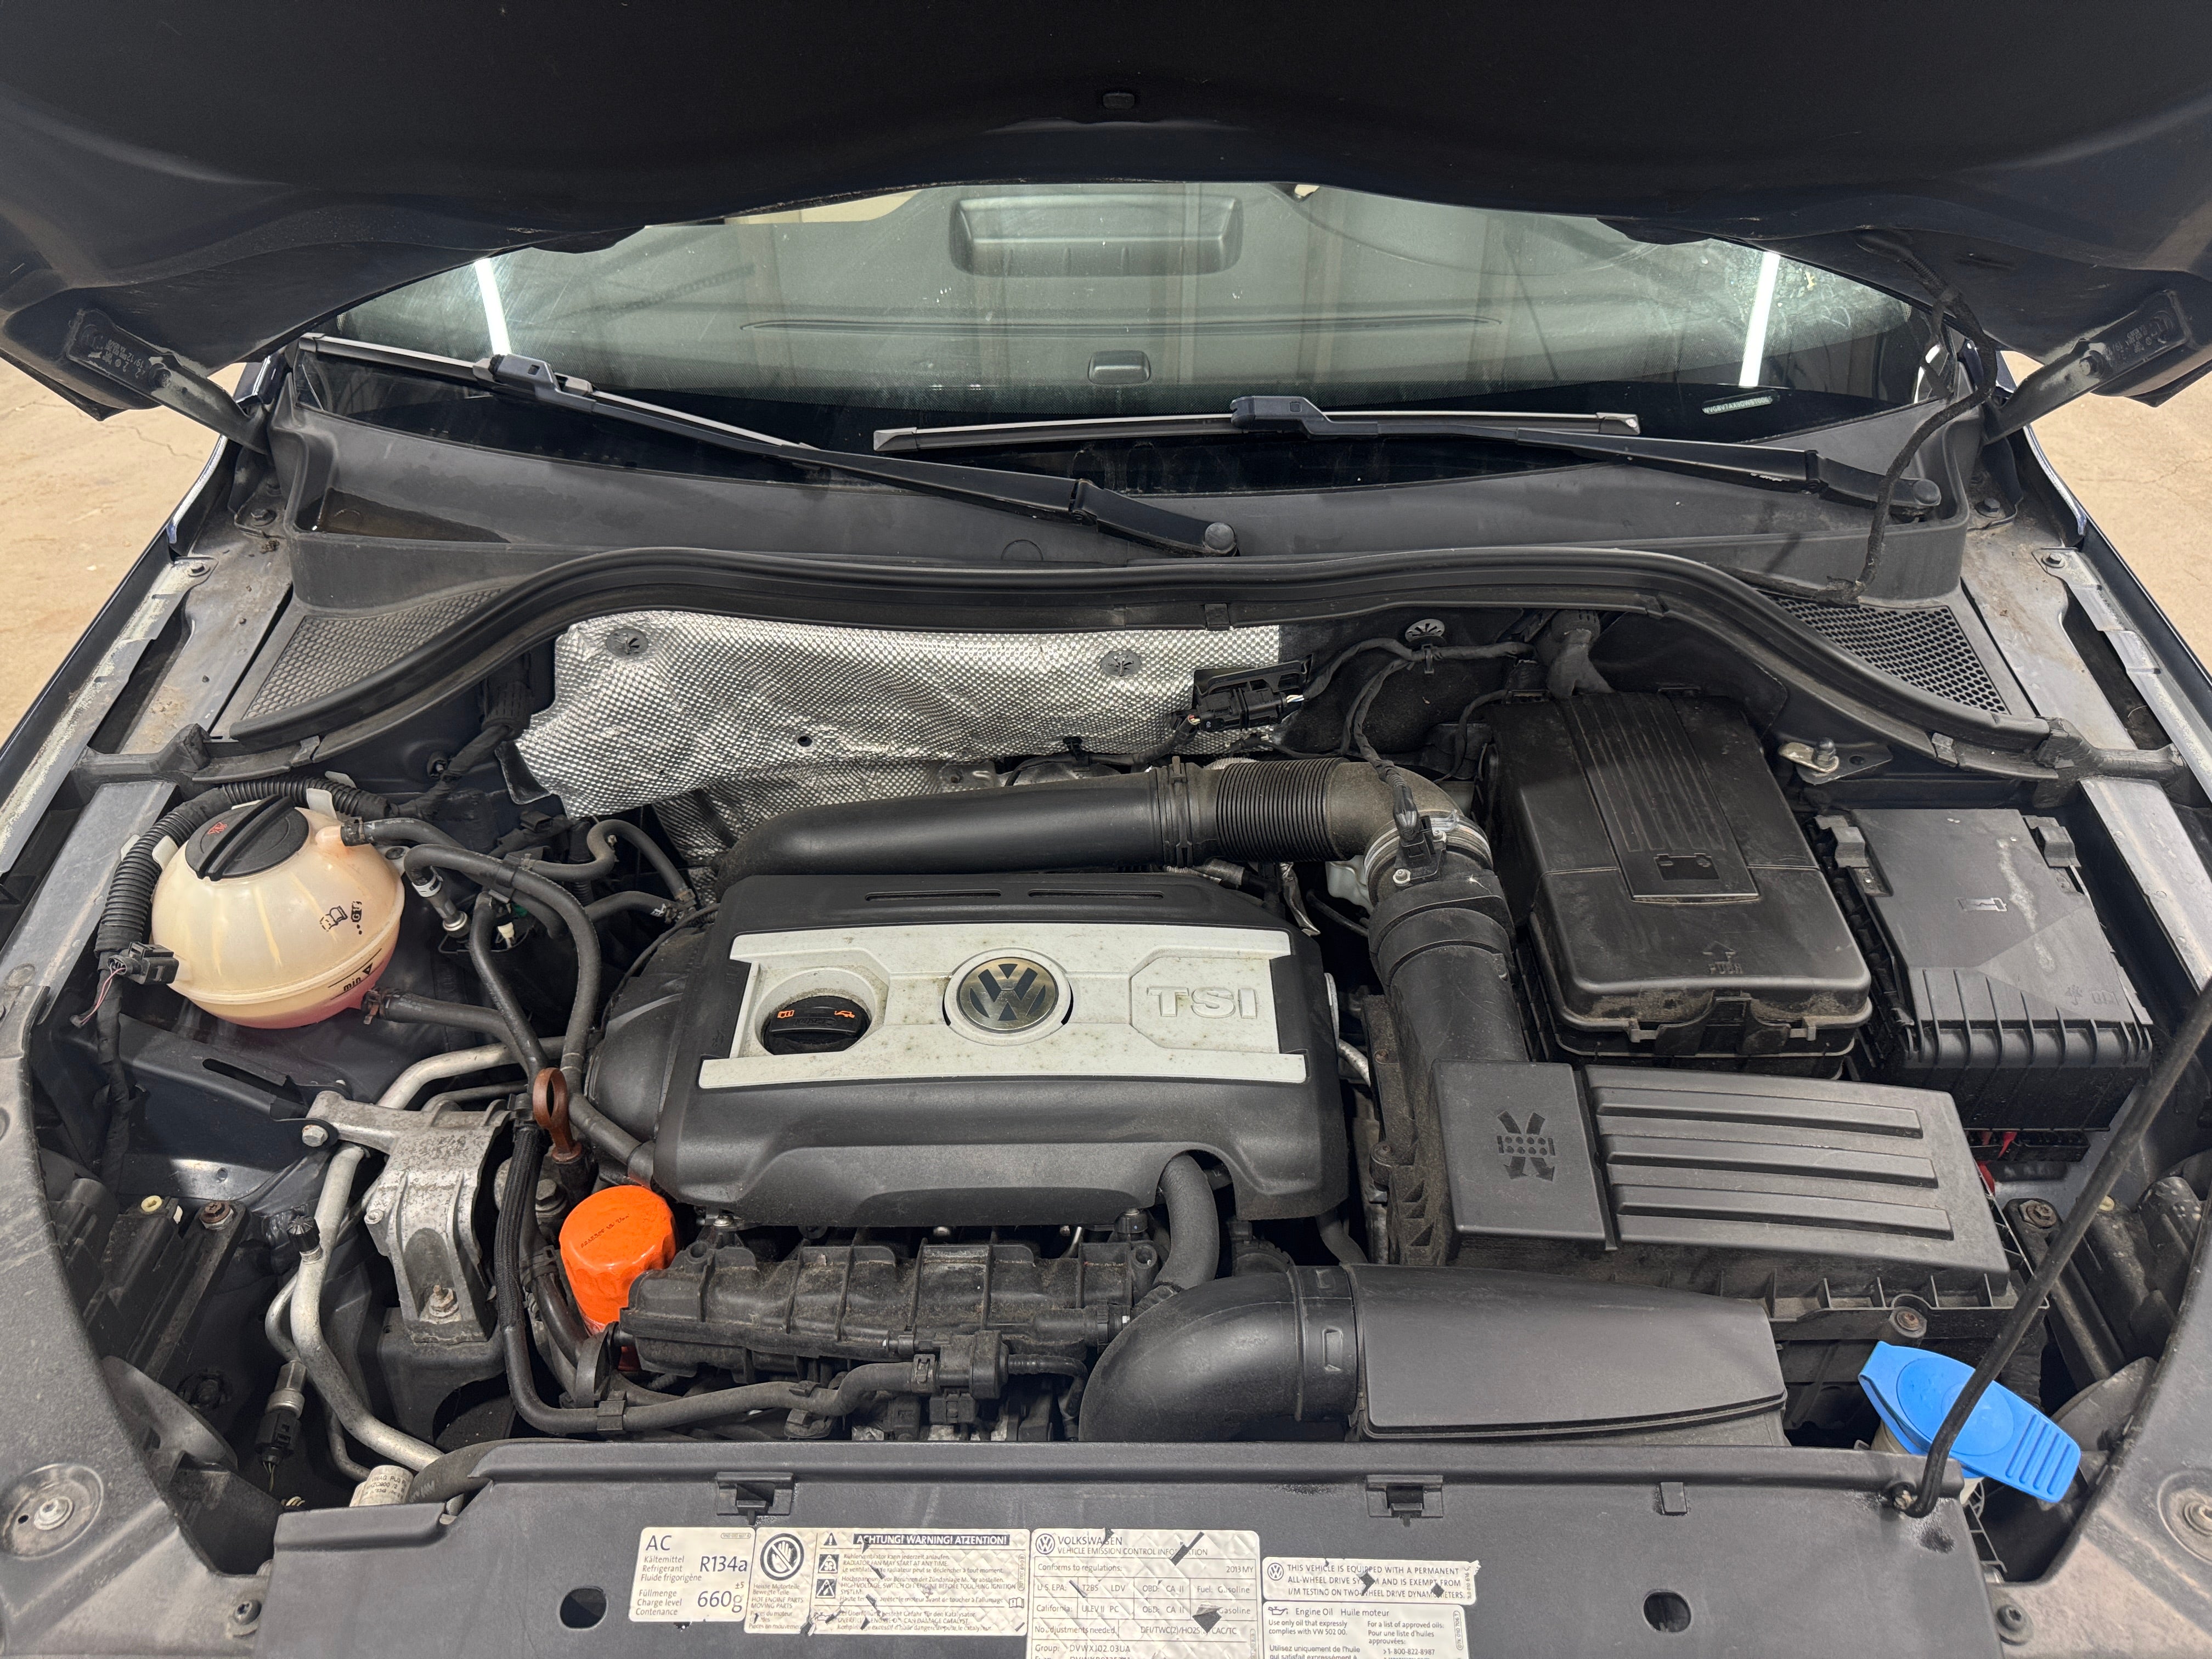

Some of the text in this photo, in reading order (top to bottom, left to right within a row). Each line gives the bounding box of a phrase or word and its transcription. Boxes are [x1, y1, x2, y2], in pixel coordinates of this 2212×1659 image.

[343, 977, 361, 991] min
[1146, 986, 1258, 1019] TSI
[646, 1535, 672, 1550] AC
[906, 1536, 952, 1544] WARNING!
[1058, 1536, 1122, 1545] VOLKSWAGEN
[700, 1556, 747, 1572] R134a
[642, 1565, 682, 1573] Refrigerant
[663, 1574, 702, 1583] frigorigène
[639, 1590, 676, 1598] Füllmenge
[637, 1599, 664, 1607] Charge
[697, 1591, 742, 1613] 660g
[1296, 1608, 1321, 1617] Engine
